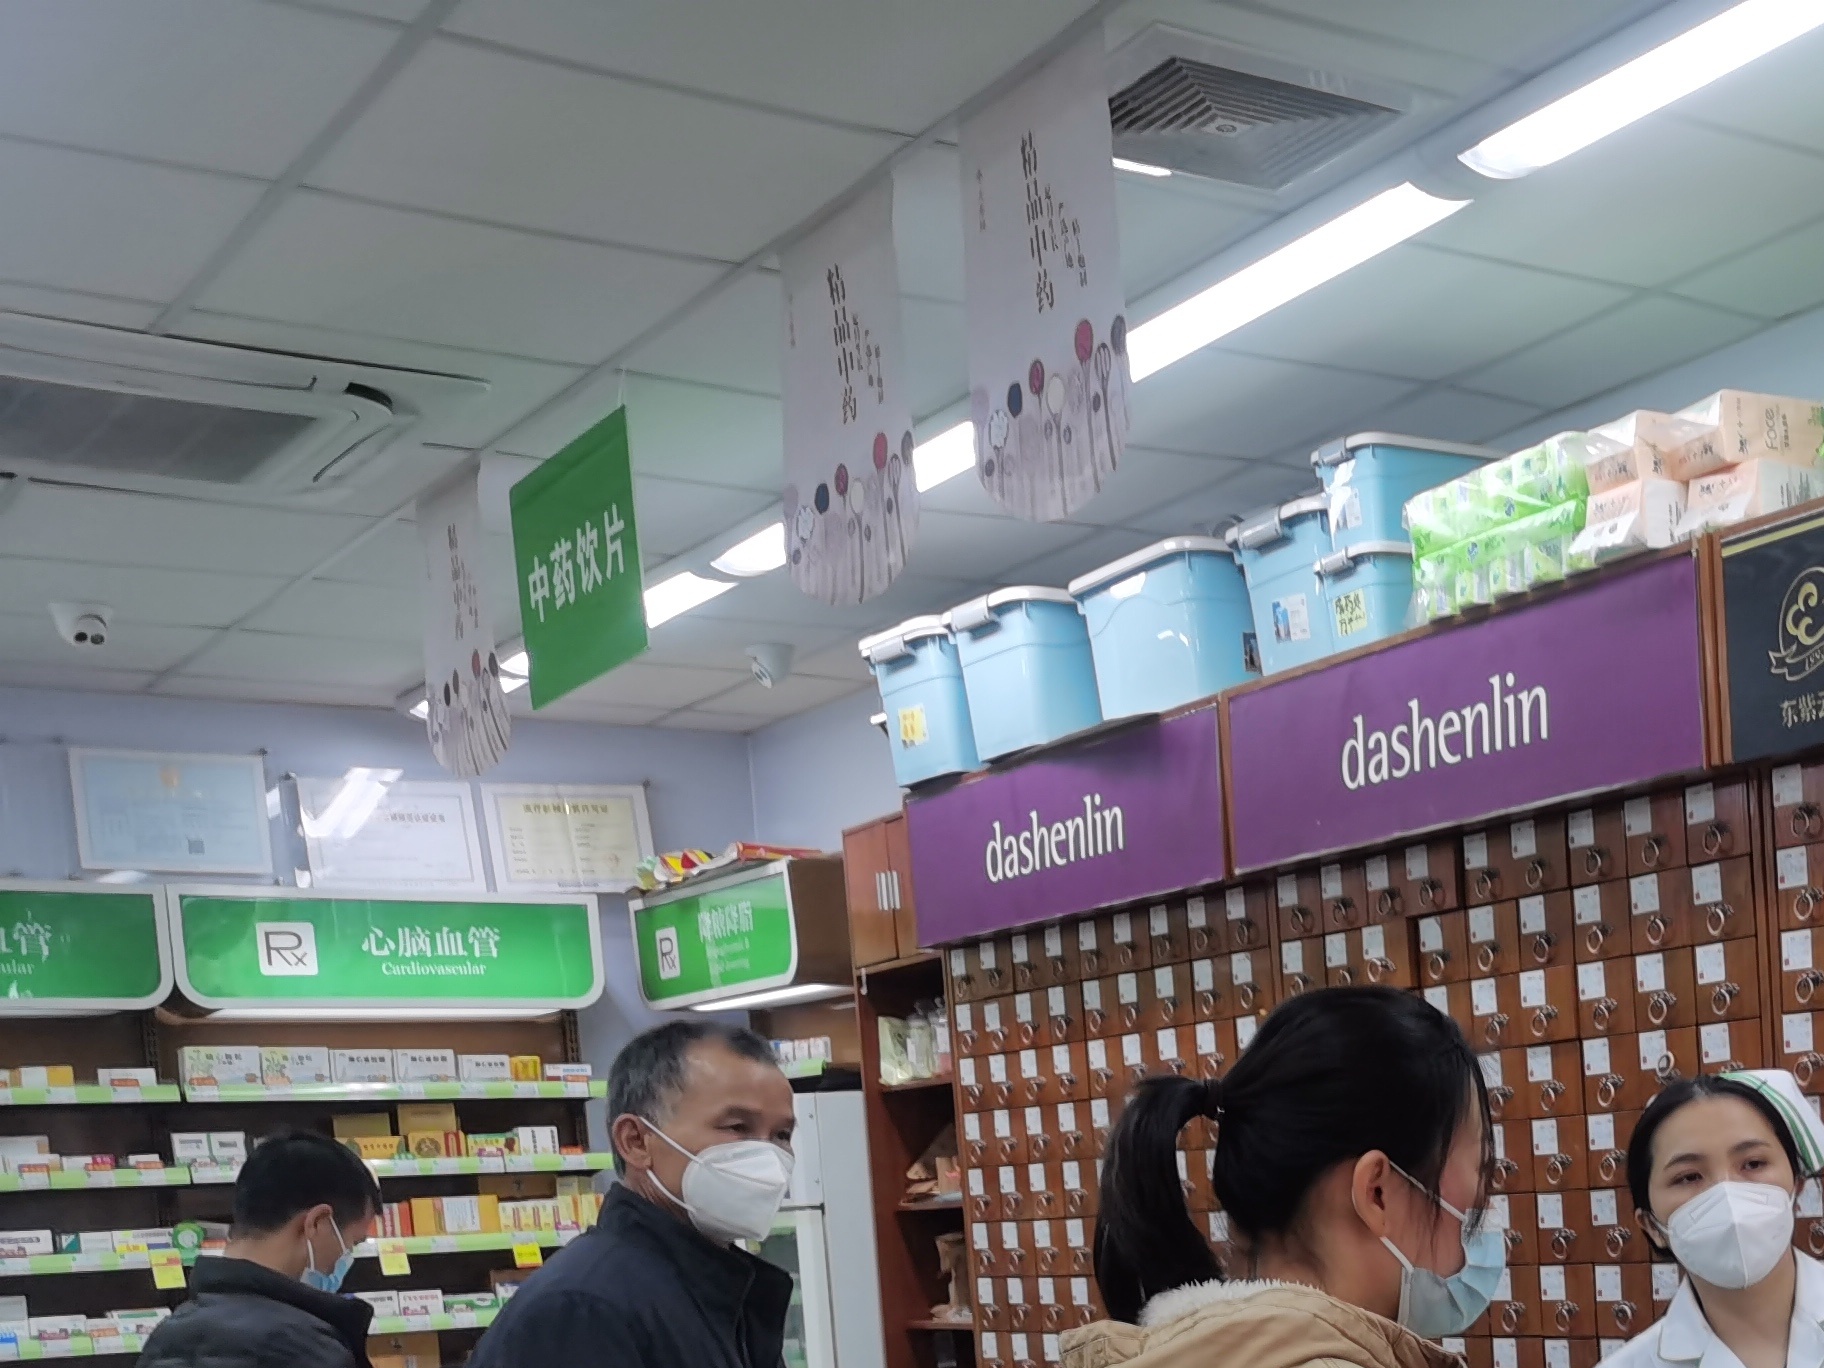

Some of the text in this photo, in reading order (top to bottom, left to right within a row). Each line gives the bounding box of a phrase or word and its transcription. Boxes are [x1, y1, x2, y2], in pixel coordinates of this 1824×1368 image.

[528, 503, 625, 622] 中药饮片
[1341, 672, 1548, 790] dashenlin
[985, 793, 1124, 882] dashenlin
[361, 925, 501, 959] 心脑血管
[381, 960, 486, 977] Cardiovascular
